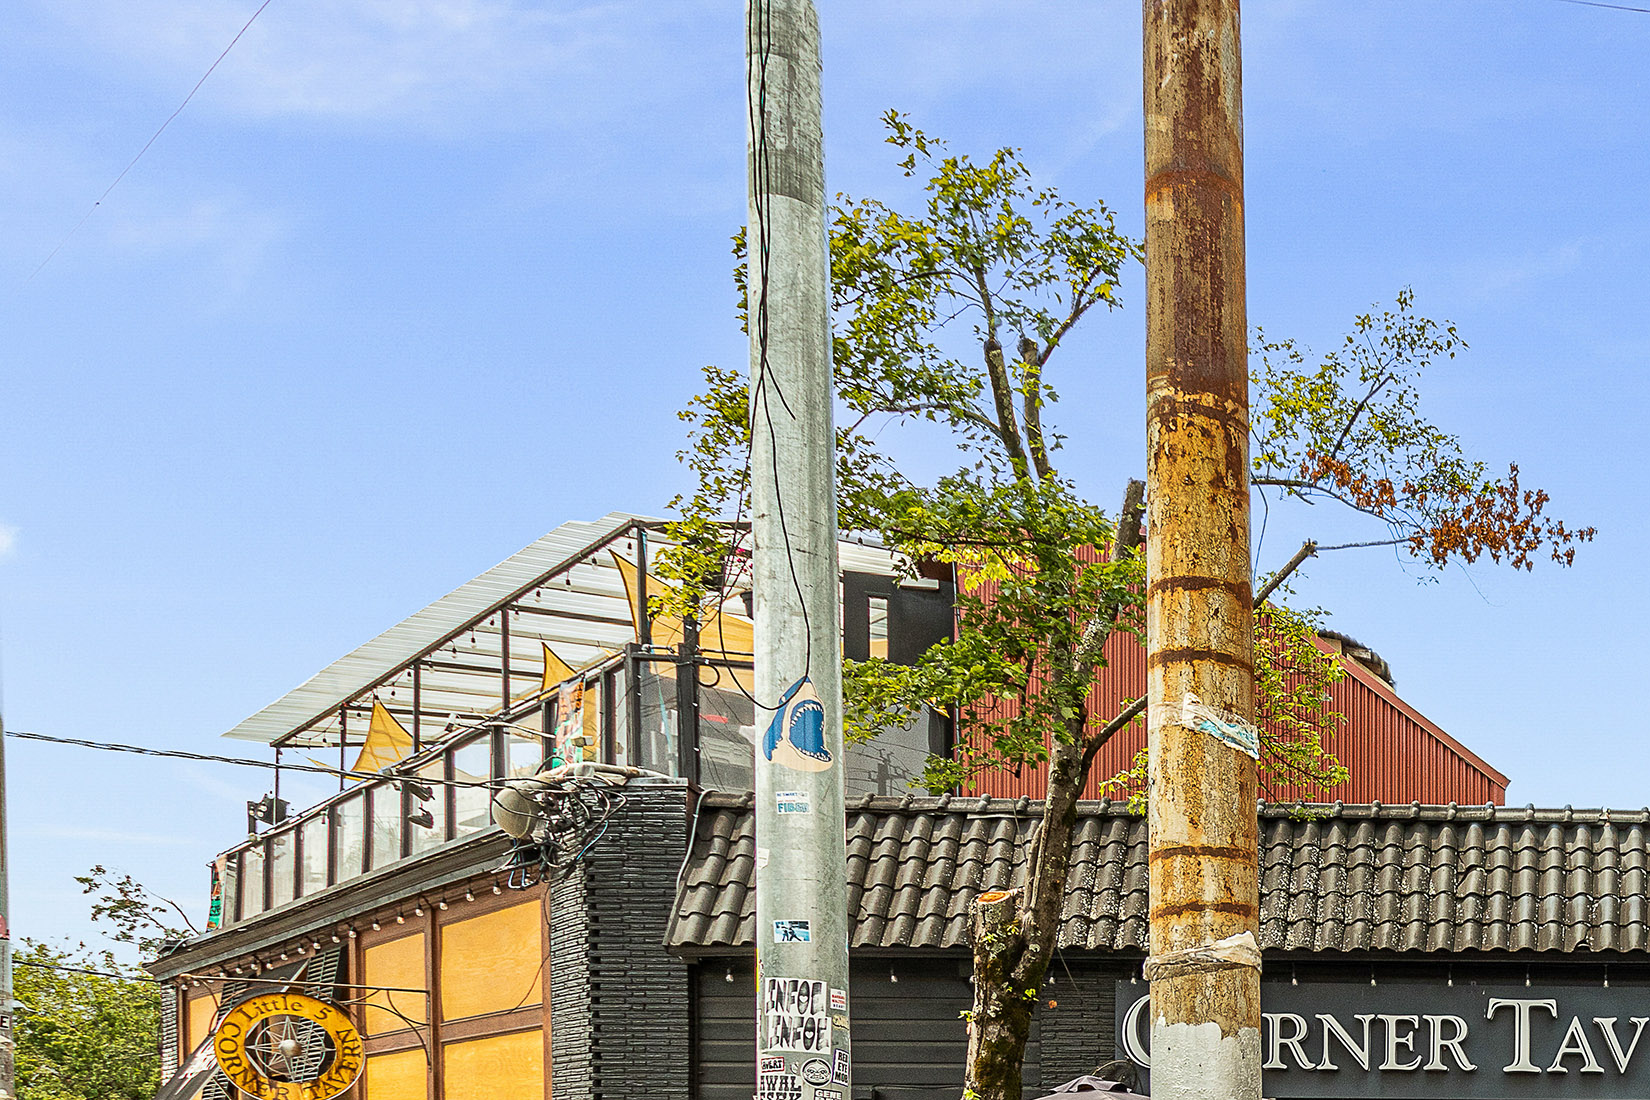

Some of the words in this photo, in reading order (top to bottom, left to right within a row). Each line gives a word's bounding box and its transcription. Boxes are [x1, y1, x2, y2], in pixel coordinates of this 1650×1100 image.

[236, 996, 305, 1022] Little
[313, 1006, 333, 1022] 5
[1121, 994, 1478, 1073] RNER
[302, 1028, 363, 1100] TAVERN
